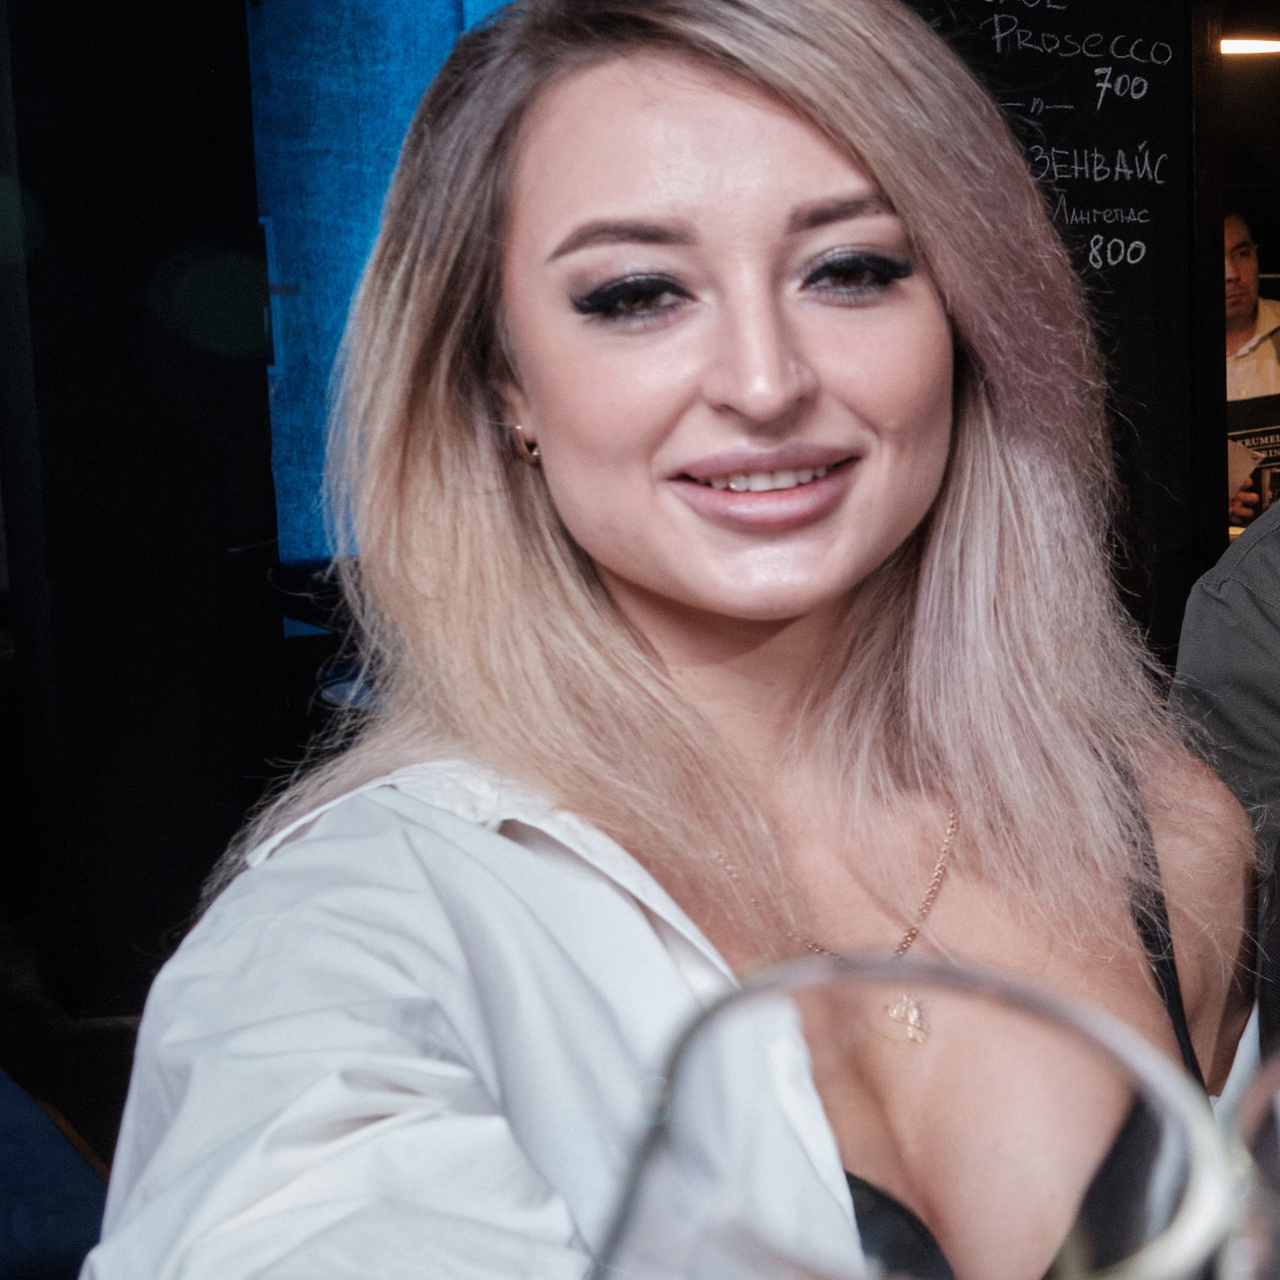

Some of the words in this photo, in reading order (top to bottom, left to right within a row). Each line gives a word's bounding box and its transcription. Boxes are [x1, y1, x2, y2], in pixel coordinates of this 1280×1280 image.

[1093, 66, 1149, 111] 700
[1029, 140, 1169, 185] ЗЕНВАЙС
[1088, 233, 1148, 269] 800
